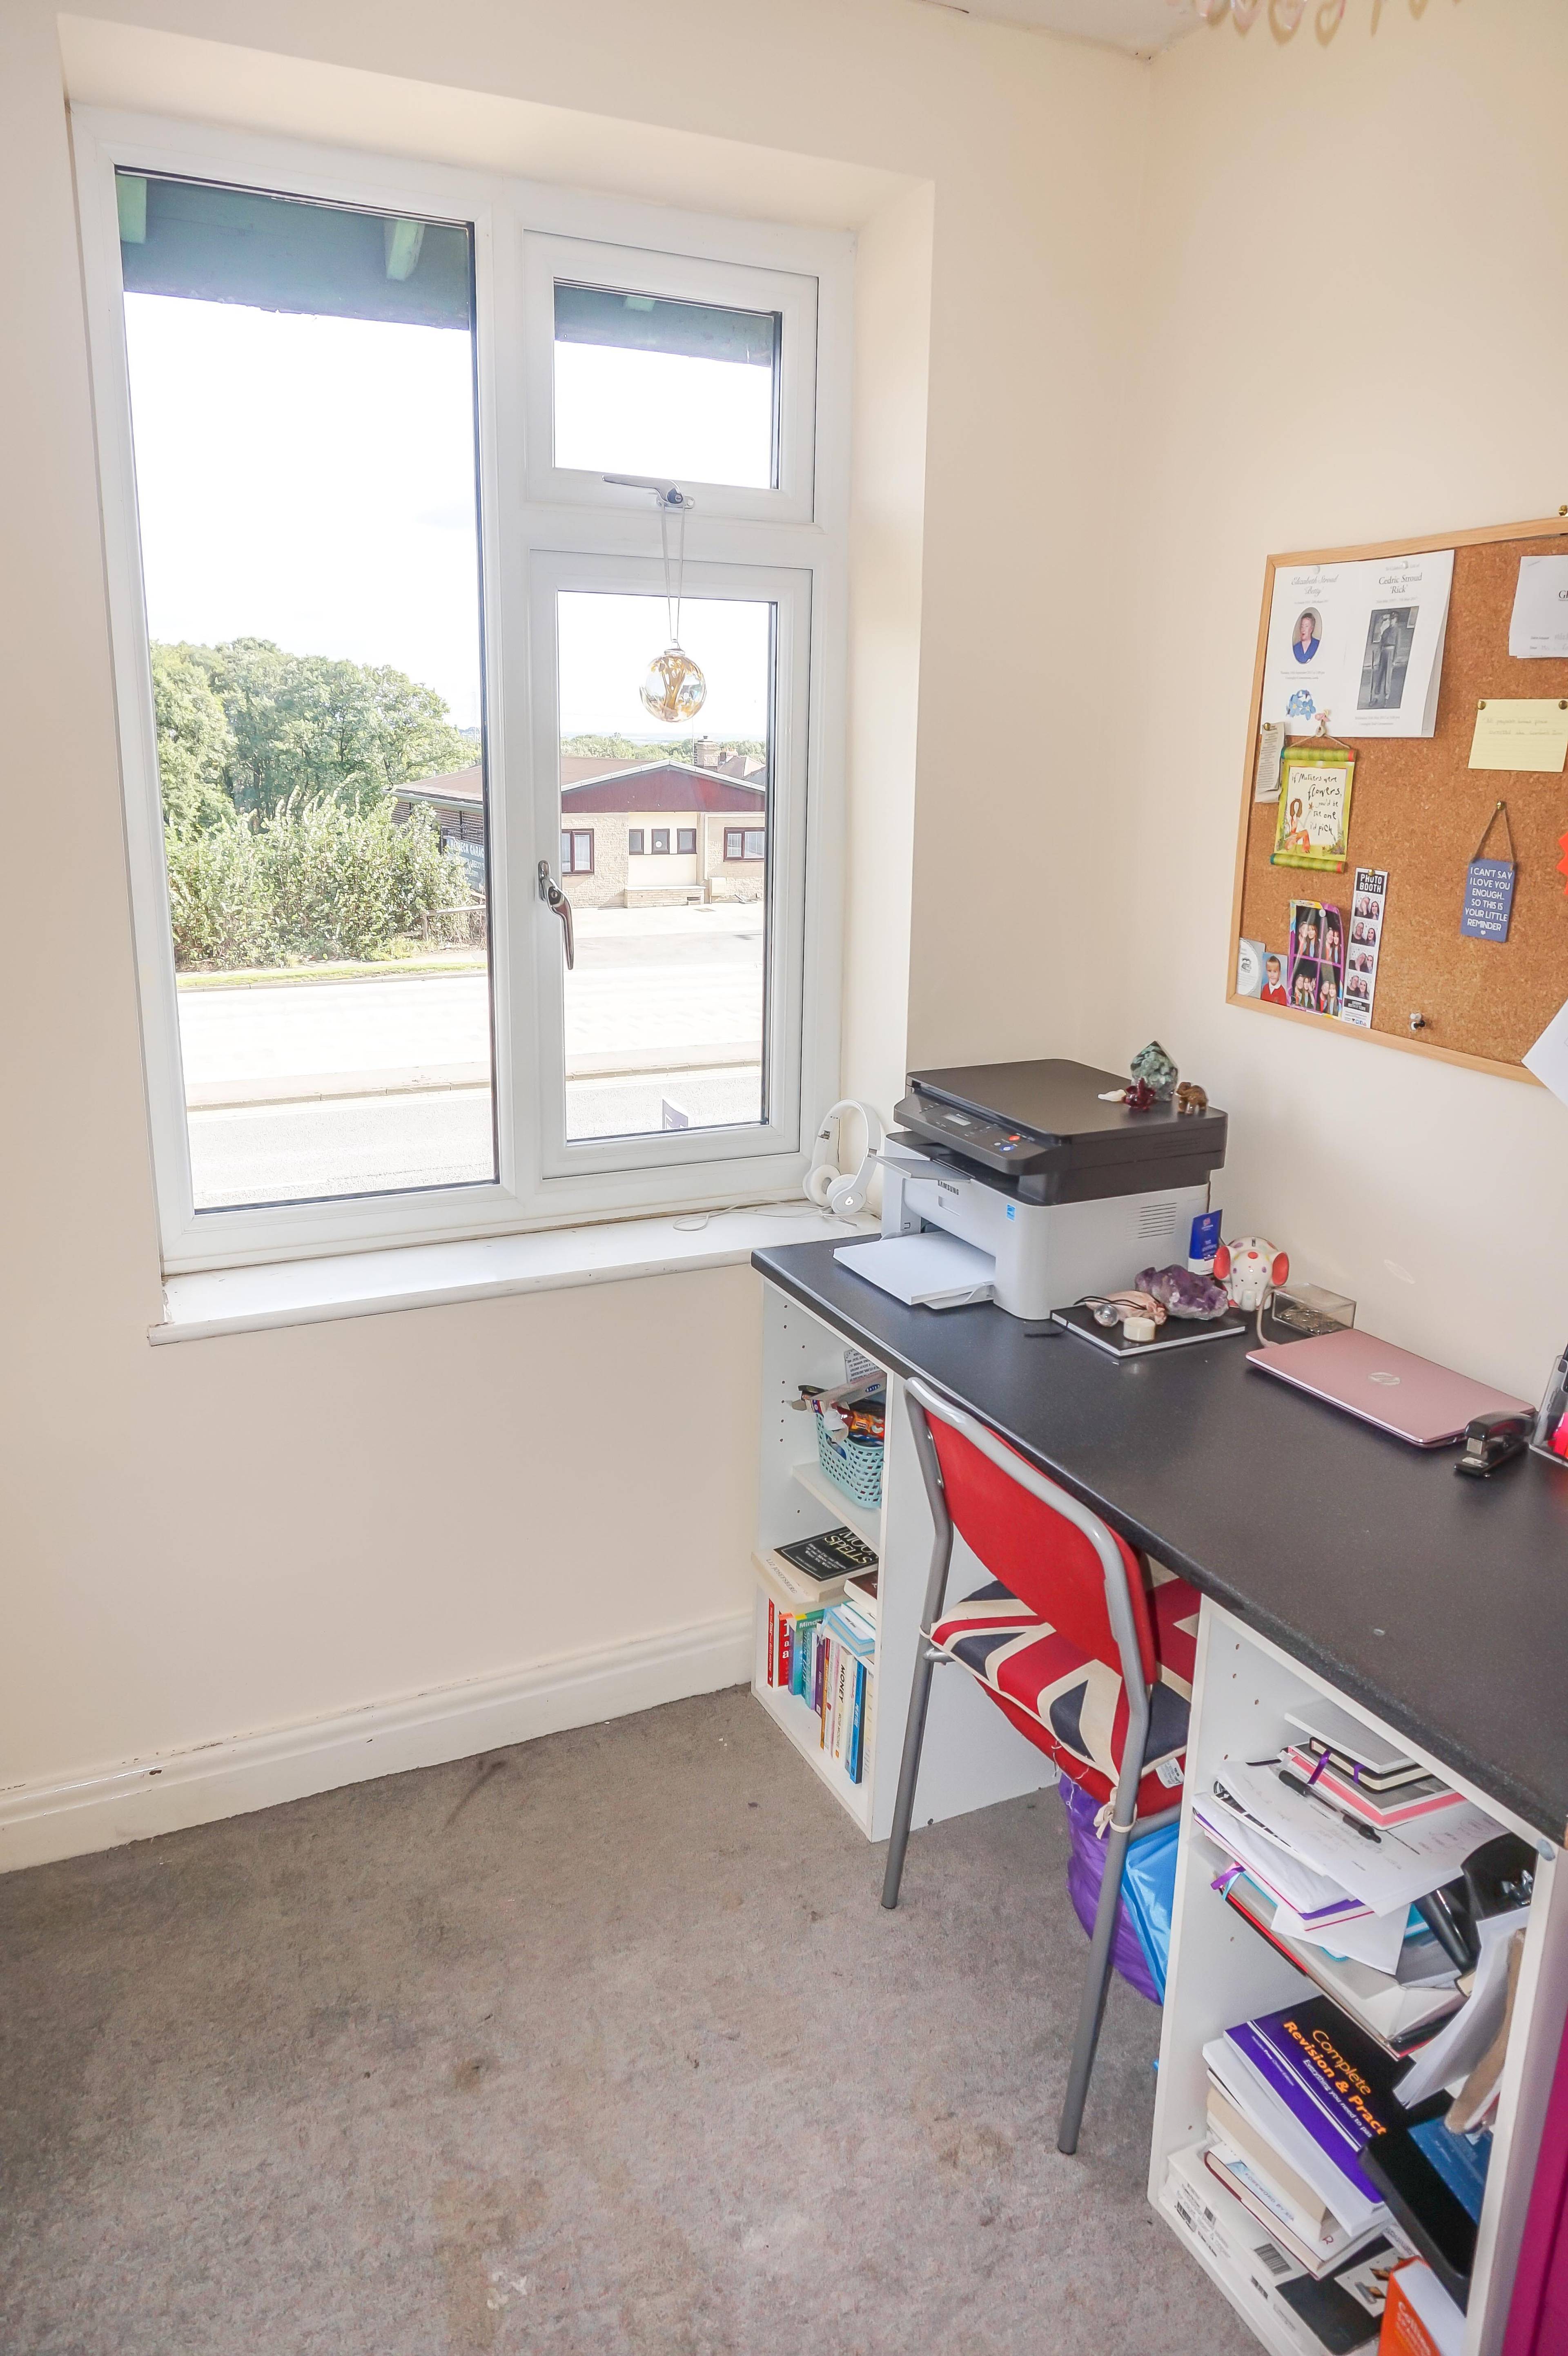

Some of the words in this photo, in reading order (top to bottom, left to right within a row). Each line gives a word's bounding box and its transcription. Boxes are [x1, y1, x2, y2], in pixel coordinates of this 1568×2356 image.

[1379, 576, 1400, 585] Cedric
[1401, 572, 1422, 582] Stroud
[1324, 811, 1336, 820] one
[470, 844, 485, 858] GARAG
[1361, 874, 1382, 884] PHOTO
[1497, 871, 1512, 879] SAY
[1360, 882, 1381, 893] BOOTH
[1473, 878, 1494, 888] LOVE
[1495, 881, 1510, 890] YOU
[1471, 898, 1481, 906] SO
[1483, 900, 1497, 910] THIS
[1465, 907, 1484, 918] YOUR
[1486, 911, 1508, 922] LITTLE
[1467, 918, 1502, 931] REMINDER
[938, 1180, 959, 1195] SAMSUNG
[824, 1536, 872, 1564] SPELLS
[839, 1531, 873, 1555] MOO
[1313, 2029, 1371, 2095] Complete
[1283, 2021, 1335, 2078] Revision
[1335, 2080, 1350, 2094] &
[1348, 2095, 1387, 2135] Pract
[1303, 2059, 1330, 2092] Everything
[1329, 2091, 1341, 2103] you
[1341, 2102, 1355, 2118] need
[1354, 2117, 1362, 2126] to
[1360, 2126, 1372, 2138] pas
[1245, 2173, 1276, 2203] FOREWORD
